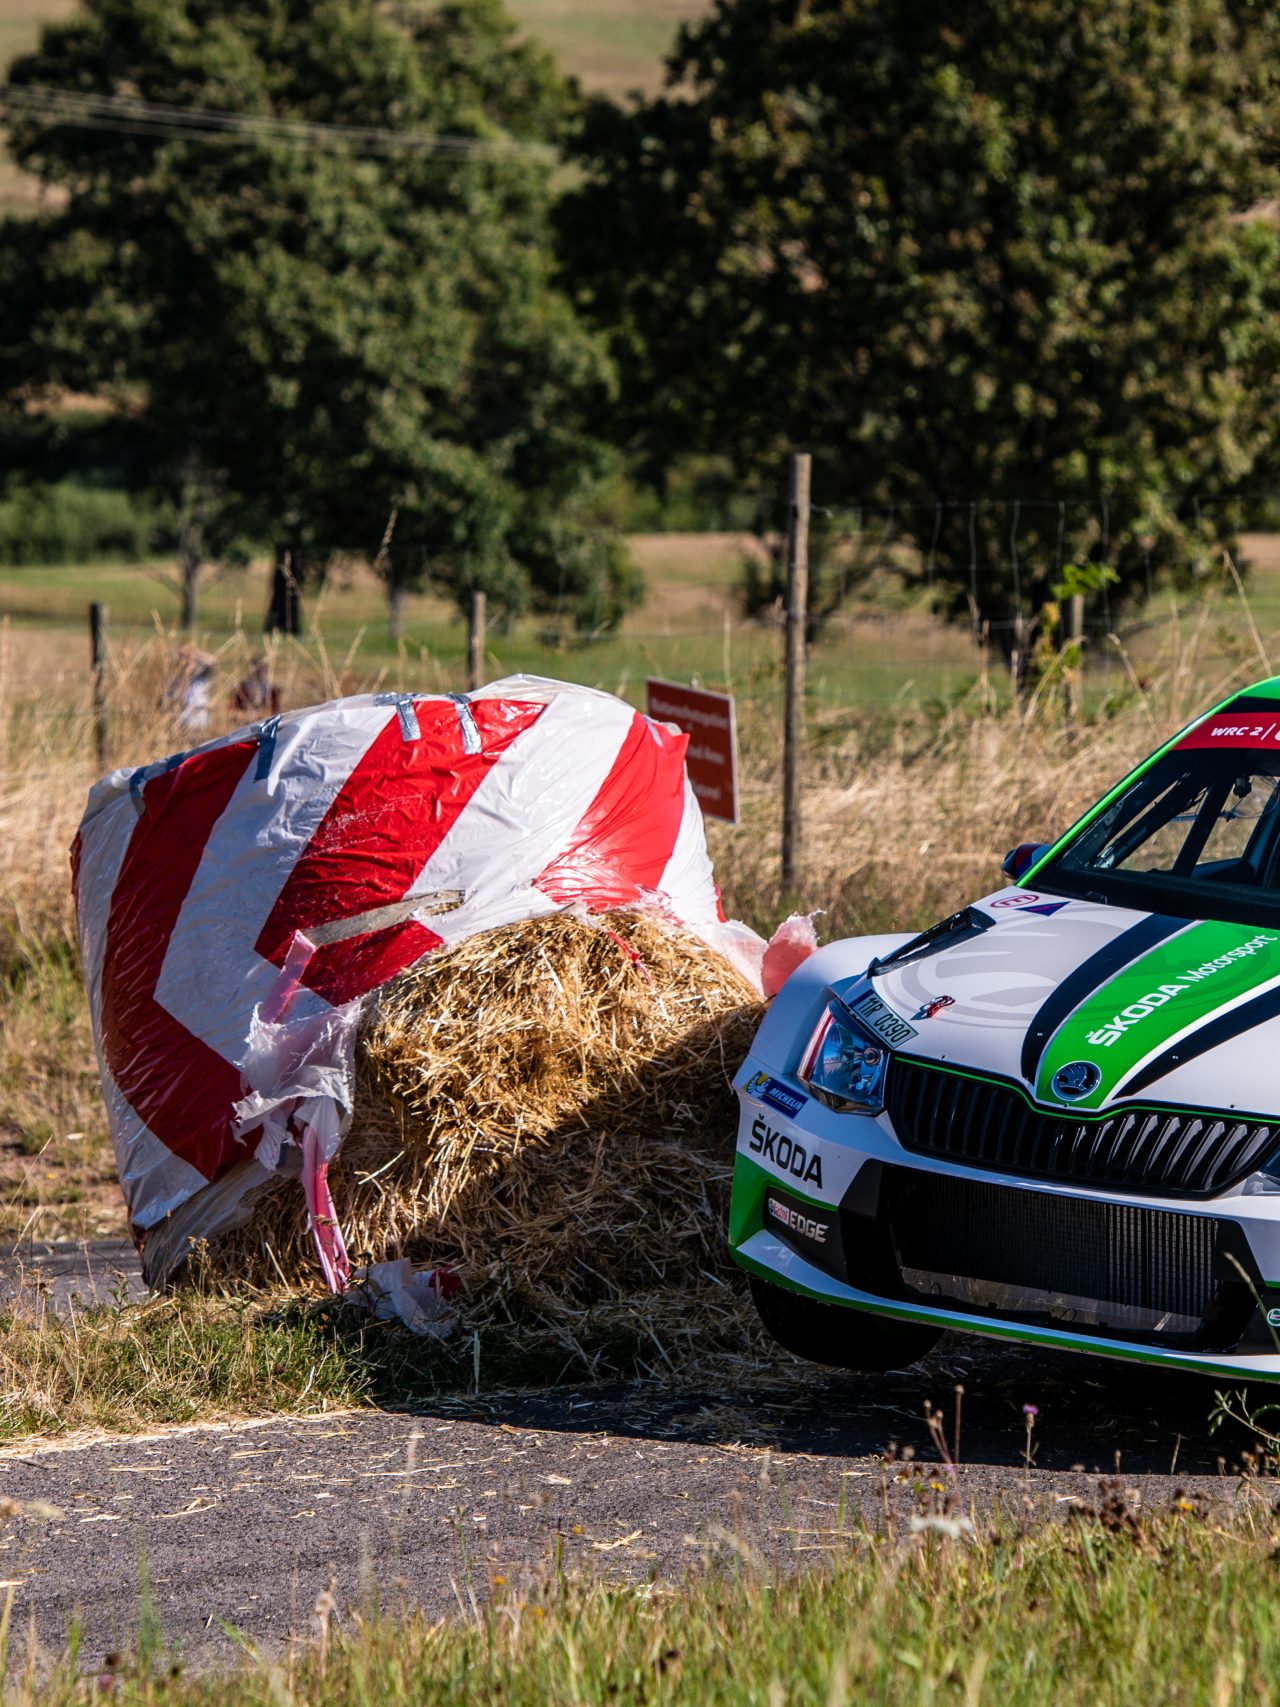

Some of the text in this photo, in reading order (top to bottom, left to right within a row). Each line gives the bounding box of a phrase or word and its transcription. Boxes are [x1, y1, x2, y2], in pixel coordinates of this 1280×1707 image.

[1211, 726, 1249, 737] WRC
[1249, 726, 1264, 736] 2
[1085, 934, 1278, 1047] ŠKODA Motorsport
[877, 1013, 912, 1044] 0390
[768, 1087, 804, 1111] MICHELIN
[749, 1113, 823, 1190] ŠKODA
[788, 1210, 830, 1244] EDGE
